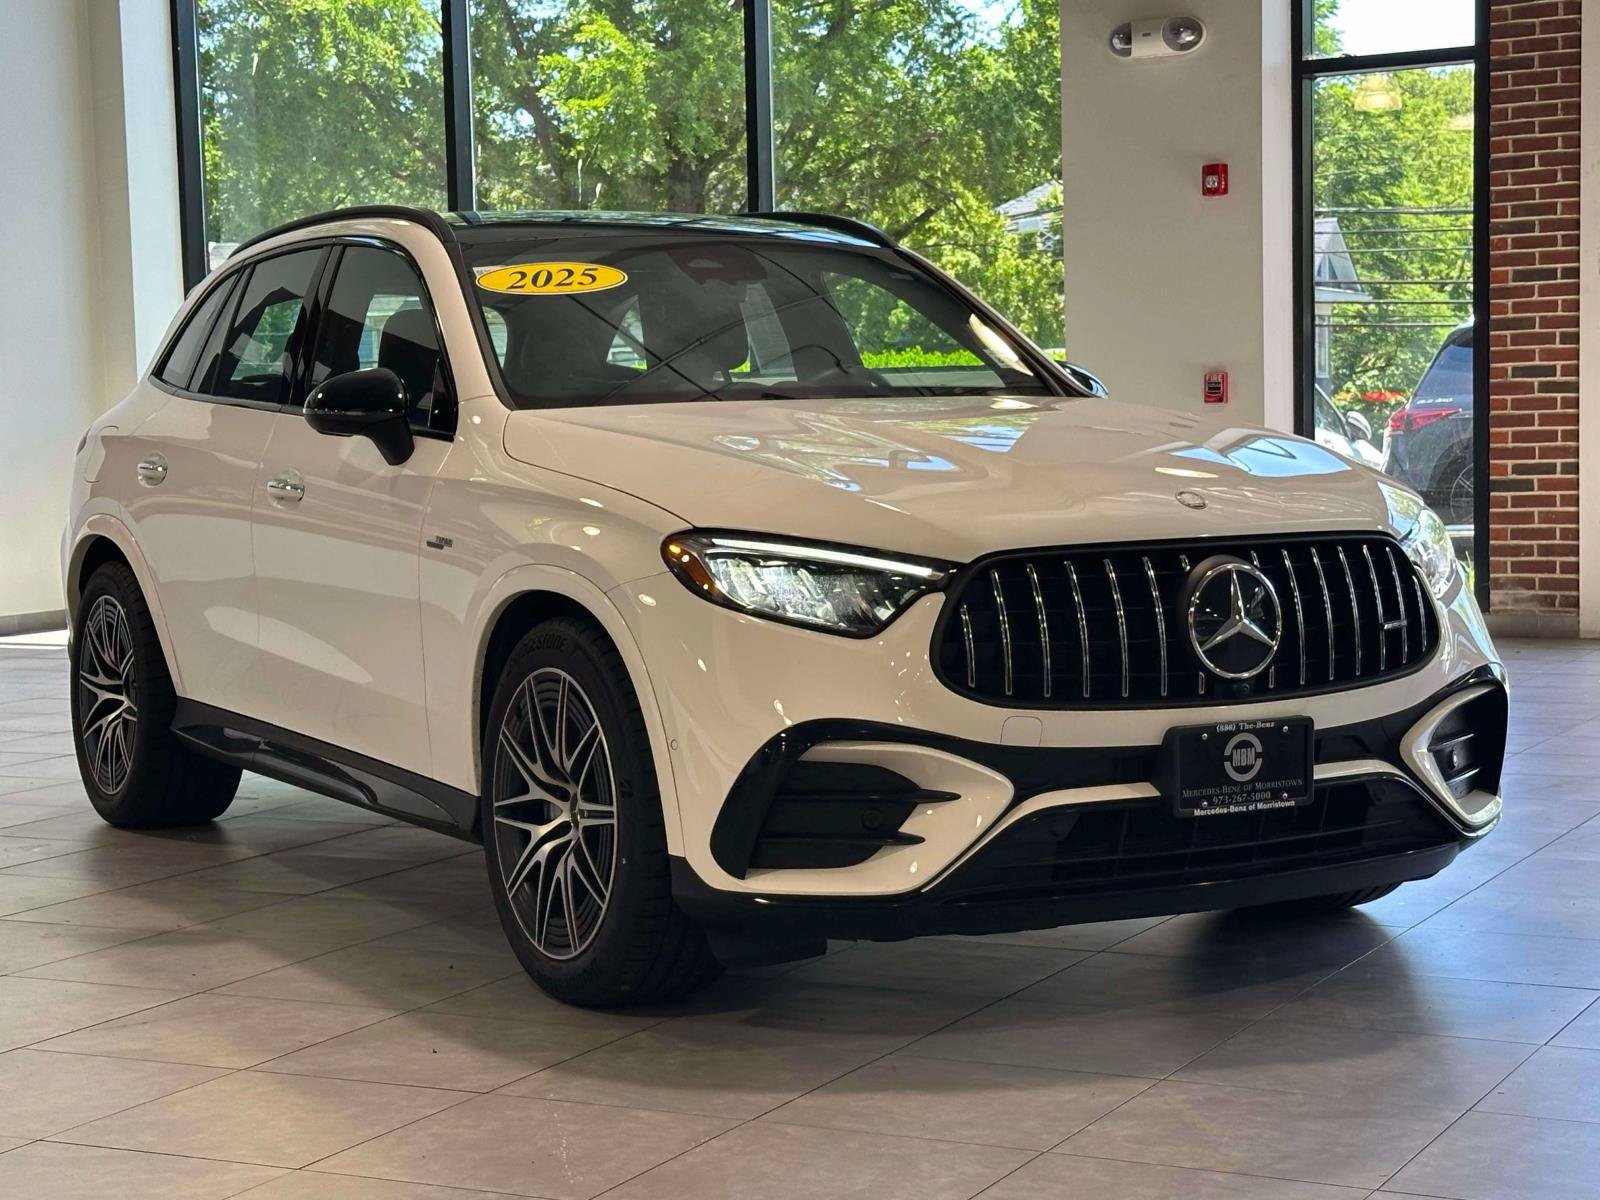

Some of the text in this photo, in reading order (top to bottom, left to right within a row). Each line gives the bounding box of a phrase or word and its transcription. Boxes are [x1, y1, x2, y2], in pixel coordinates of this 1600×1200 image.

[506, 267, 599, 290] 2025
[1239, 720, 1275, 730] The-Benz
[1232, 747, 1256, 767] MBM
[1182, 785, 1241, 798] MERCEDES-BENZ
[1255, 779, 1303, 790] MORRISTOWN
[1212, 791, 1271, 805] 973-267-5000
[1194, 805, 1247, 816] Mercedes-Benz
[1257, 800, 1295, 810] Morristown
